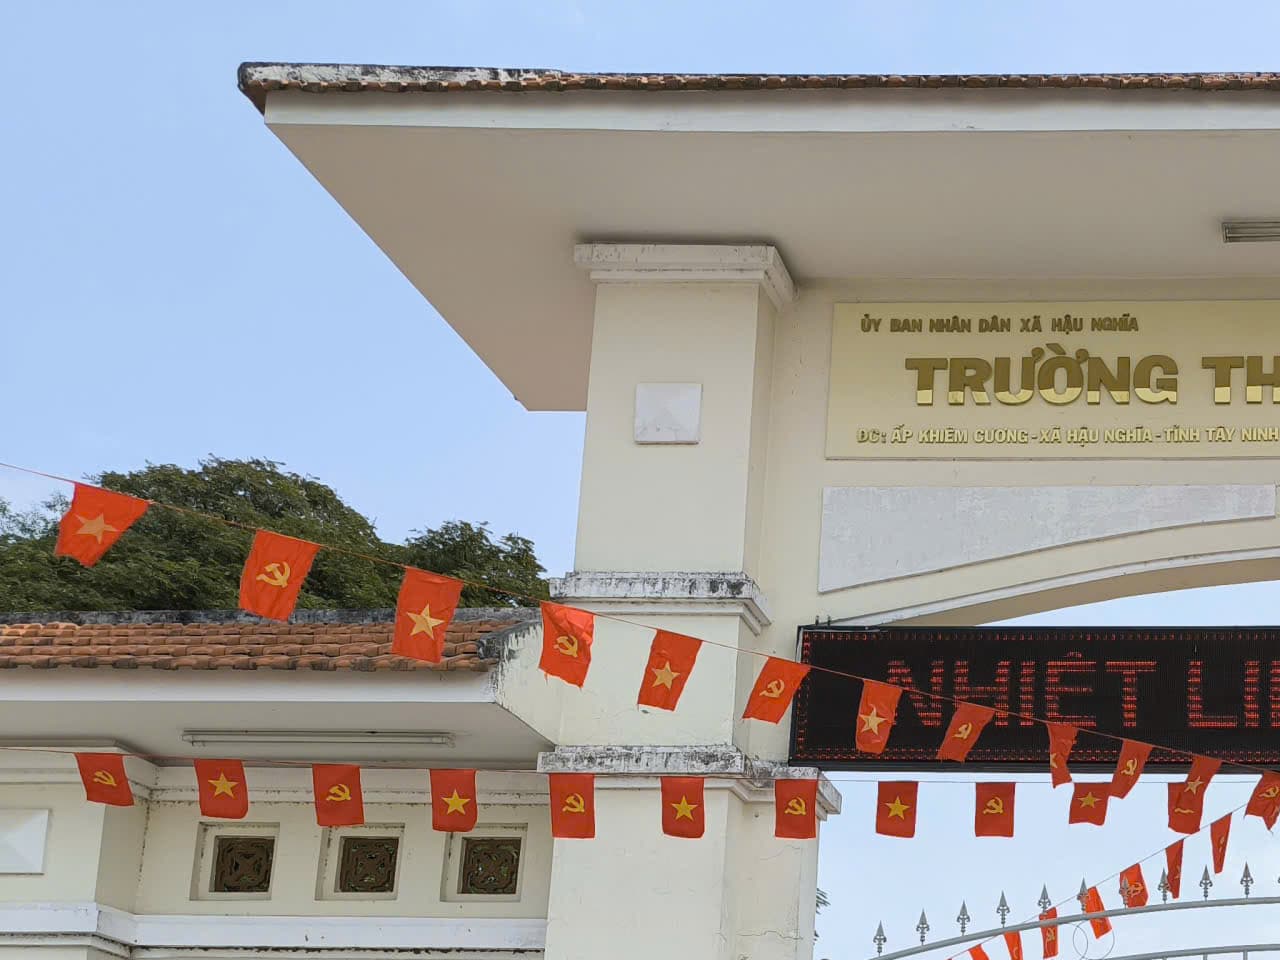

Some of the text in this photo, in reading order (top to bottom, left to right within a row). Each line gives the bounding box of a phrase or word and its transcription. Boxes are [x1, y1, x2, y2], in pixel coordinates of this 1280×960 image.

[860, 313, 1139, 335] ỦY BAN NHÂN DÂN XÃ HẬU NGHĨA
[905, 343, 1179, 405] TRƯỜNG
[890, 423, 913, 443] ẤP
[1066, 427, 1099, 447] HẬU
[1206, 426, 1235, 443] TÂY
[1241, 427, 1280, 442] NINH
